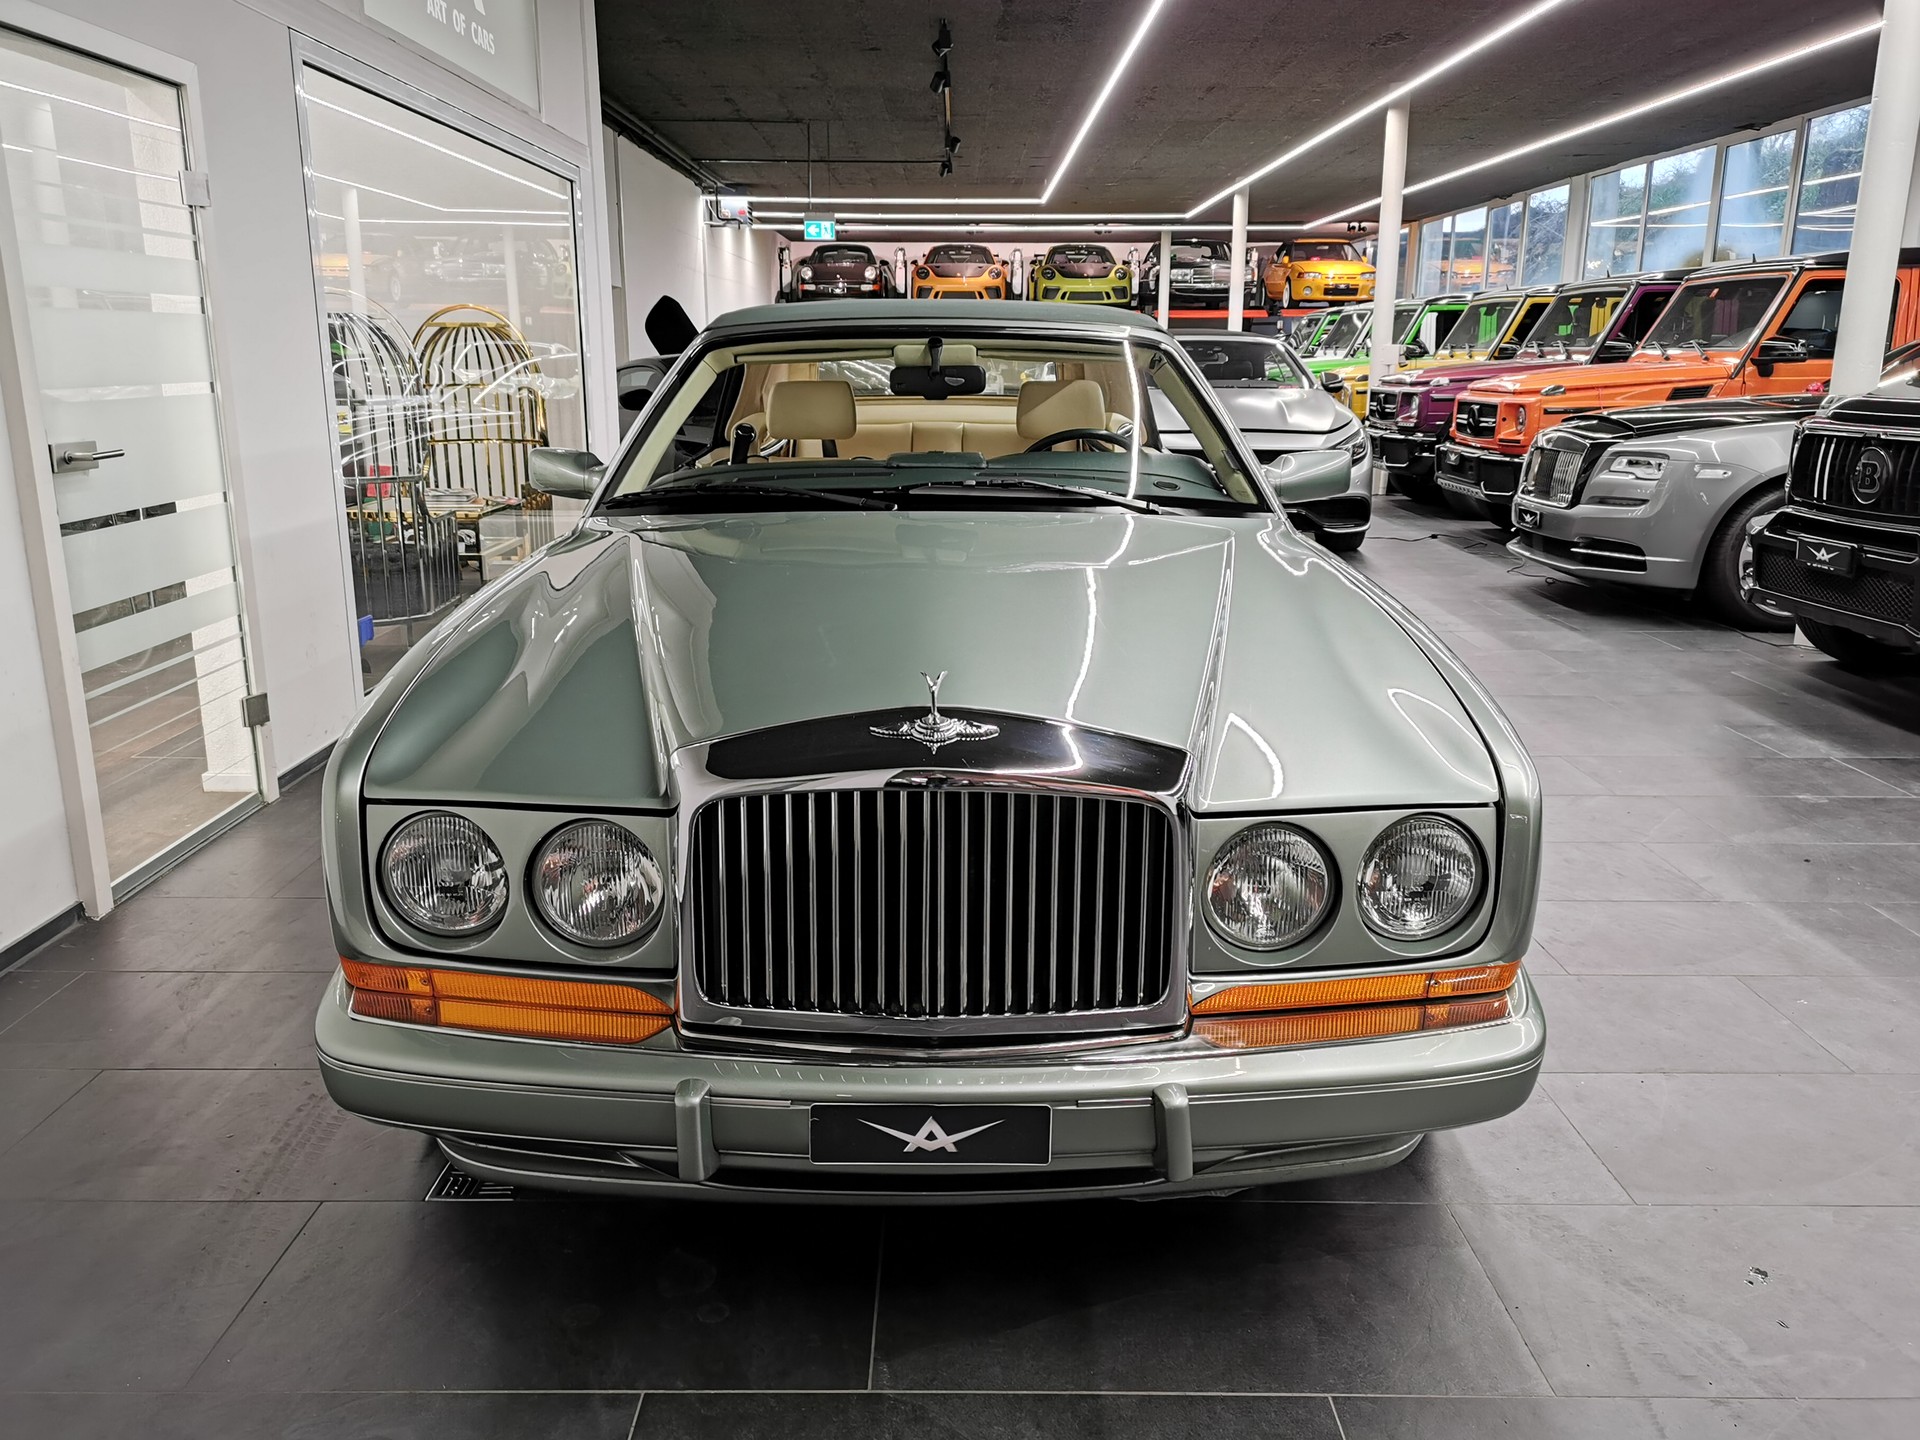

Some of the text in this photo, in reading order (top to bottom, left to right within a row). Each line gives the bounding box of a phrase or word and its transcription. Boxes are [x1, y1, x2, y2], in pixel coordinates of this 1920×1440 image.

[427, 0, 495, 55] ART OF CARS
